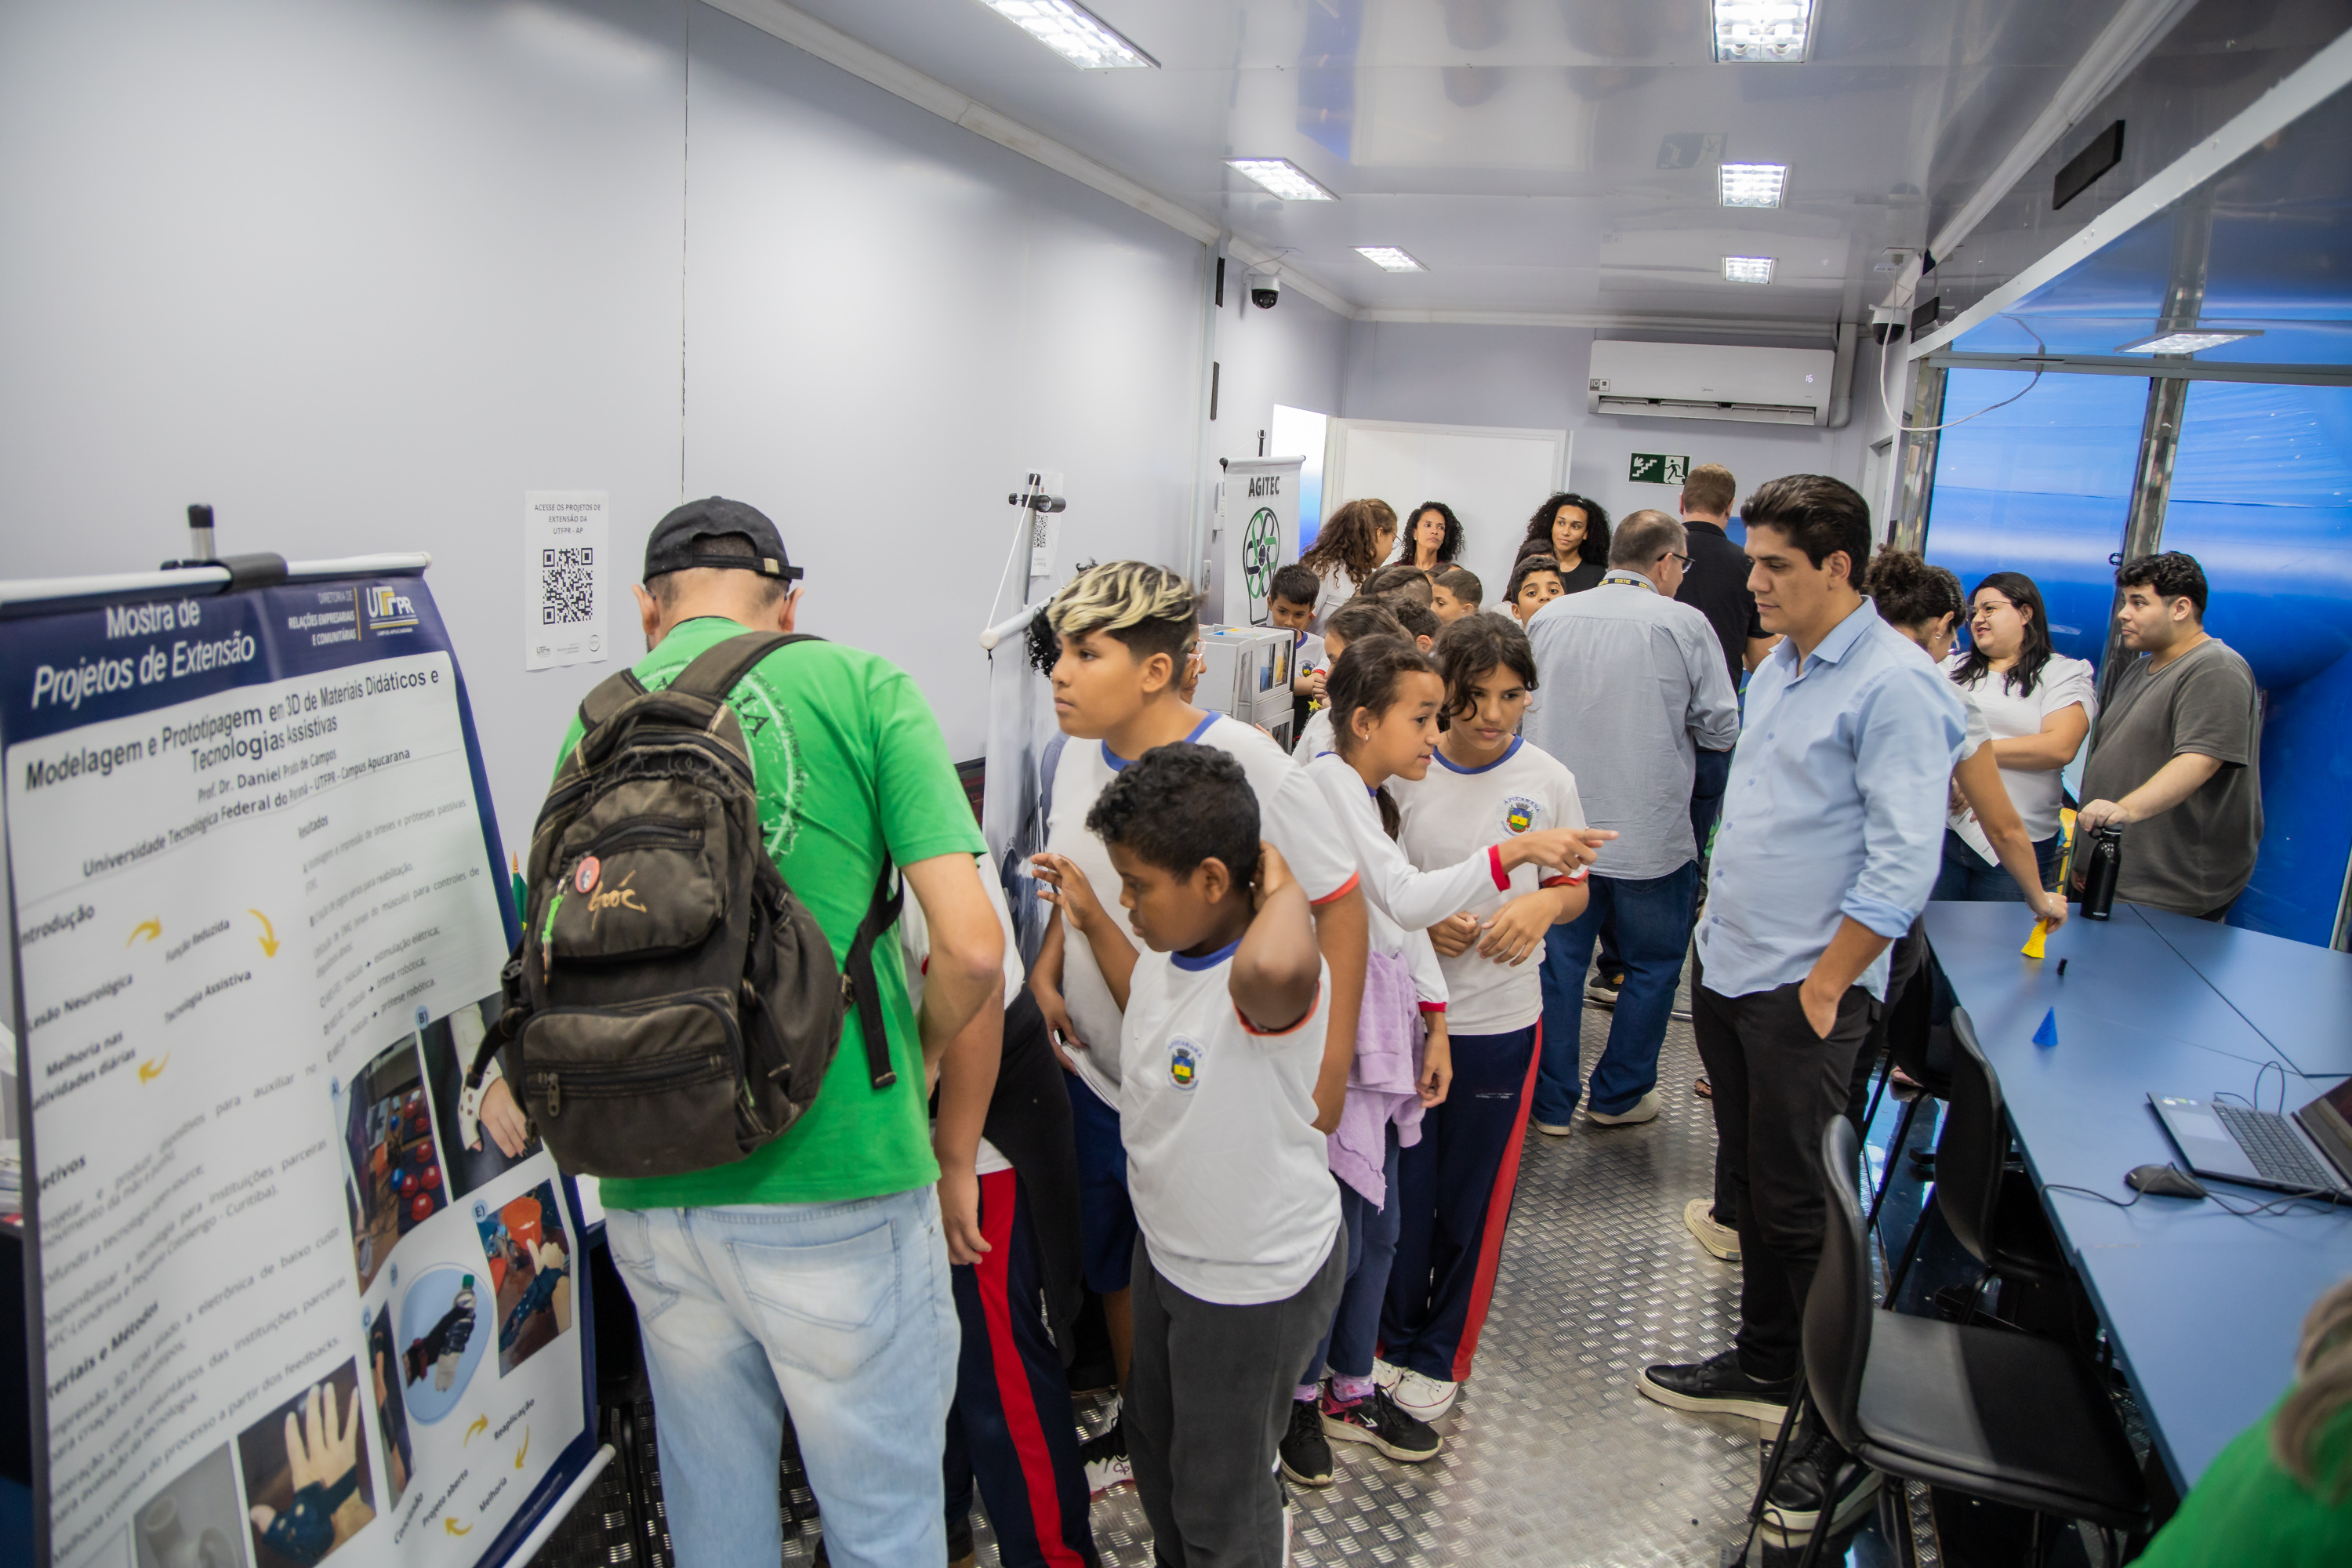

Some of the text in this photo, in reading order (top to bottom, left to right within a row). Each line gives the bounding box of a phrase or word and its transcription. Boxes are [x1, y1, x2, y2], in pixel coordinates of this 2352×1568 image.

[1248, 475, 1280, 497] AGITEC
[549, 514, 579, 523] EXTENSÃO
[107, 598, 200, 639] Mostra de
[289, 612, 318, 630] RELAÇÕES
[318, 610, 354, 626] EMPRESARIAIS
[366, 586, 415, 618] UTFPR
[312, 627, 356, 646] E COMUNITÁRIAS
[31, 630, 256, 710] Projetos de Extensão
[26, 670, 439, 791] Modelagem e Prototipagem em 3D de Materiais Didáticos e
[191, 715, 337, 773] Tecnologias Assistivas
[198, 749, 337, 804] Prof. Dr. Daniel Prado de Campos
[83, 834, 165, 877] Universidade
[167, 811, 219, 846] Tecnológica
[221, 795, 270, 821] Federal
[274, 793, 288, 807] do
[314, 771, 336, 790] UTFPR
[341, 758, 366, 781] Campus
[368, 750, 411, 772] Apucarana
[404, 808, 435, 826] próteses
[437, 799, 466, 816] passivas
[1504, 797, 1540, 813] APUCARANA
[298, 815, 328, 840] Resultados
[376, 862, 414, 884] reabilitação.
[381, 891, 410, 912] músculo)
[413, 885, 430, 898] para
[434, 872, 466, 891] controles
[470, 866, 479, 877] de
[165, 919, 230, 964] Função Reduzida
[374, 939, 411, 964] estimulação
[412, 926, 441, 945] elétrica;
[397, 956, 426, 977] robótica;
[64, 973, 133, 1014] Neurológica
[165, 971, 252, 1024] Tecnologia Assistiva
[380, 978, 436, 1014] prótese robótica.
[418, 1011, 428, 1024] B)
[46, 1031, 123, 1079] Melhoria nas
[99, 1048, 136, 1076] diárias
[216, 1095, 241, 1118] para
[253, 1073, 295, 1098] auxiliar
[305, 1063, 317, 1077] no
[39, 1154, 85, 1190] etivos
[180, 1201, 202, 1226] para
[209, 1164, 274, 1205] instituições
[281, 1138, 327, 1173] parceiras
[475, 1205, 485, 1218] E)
[198, 1275, 255, 1316] eletrônica
[260, 1264, 275, 1279] de
[280, 1245, 311, 1269] baixo
[315, 1226, 339, 1248] custo
[209, 1348, 230, 1368] das
[234, 1307, 298, 1352] instituições
[303, 1276, 347, 1314] parceiras
[47, 1356, 96, 1401] teriais
[100, 1346, 108, 1361] e
[227, 1386, 259, 1417] partir
[262, 1372, 283, 1392] dos
[285, 1336, 340, 1377] feedbacks.
[494, 1398, 535, 1441] Reaplicação
[422, 1469, 469, 1528] Projeto aberto
[478, 1477, 508, 1514] Melhoria
